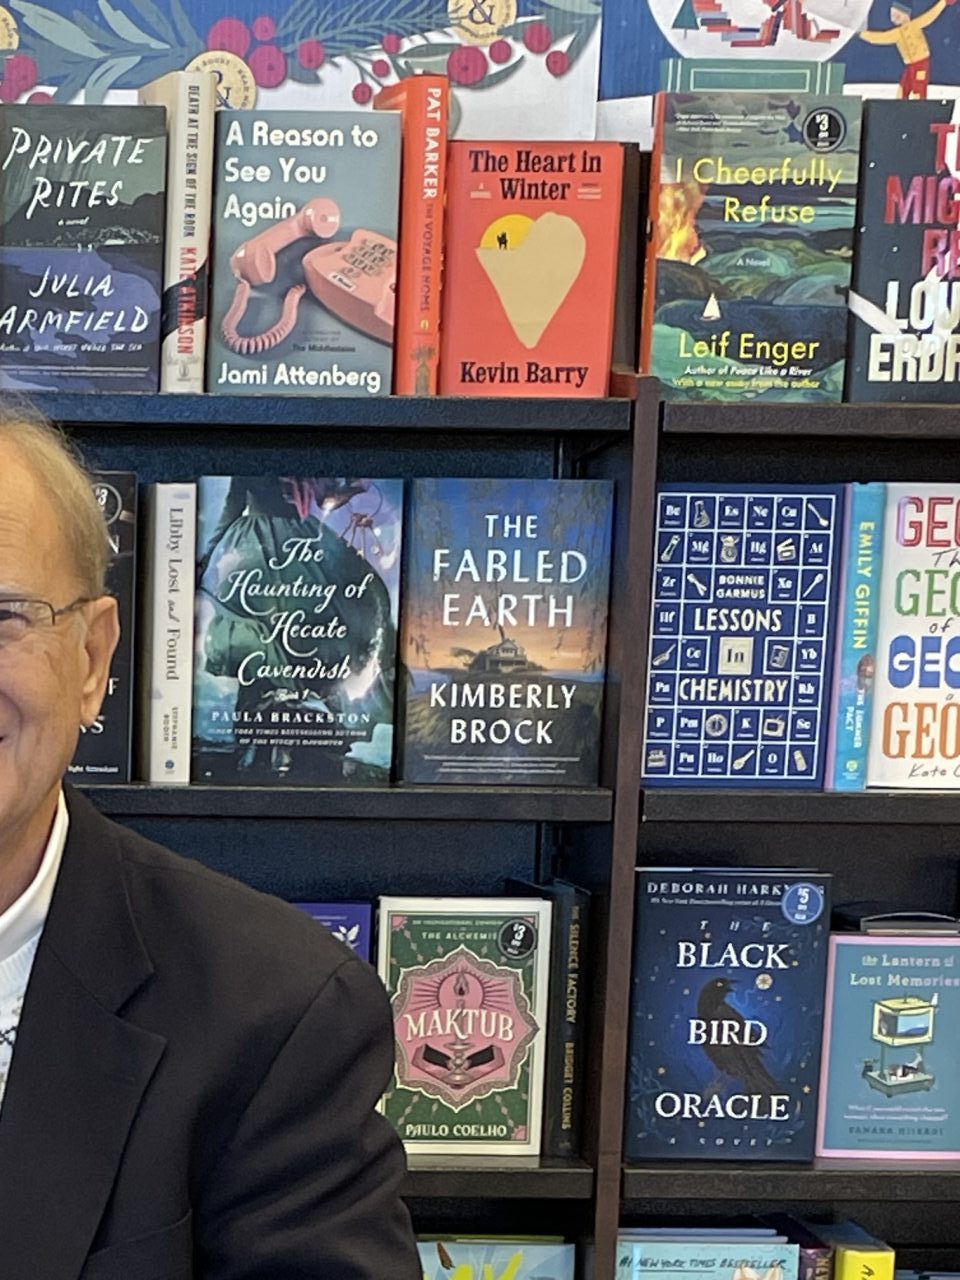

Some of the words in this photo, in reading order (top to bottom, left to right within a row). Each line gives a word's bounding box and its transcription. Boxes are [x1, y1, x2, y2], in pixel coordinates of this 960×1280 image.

[188, 85, 200, 114] DEATH
[427, 87, 441, 121] PAT
[187, 118, 198, 130] AT
[226, 120, 245, 147] A
[253, 120, 344, 148] Reason
[352, 124, 379, 148] to
[2, 127, 154, 171] PRIVATE
[186, 133, 198, 150] THE
[185, 153, 198, 174] SIGN
[224, 160, 271, 183] See
[280, 158, 327, 184] You
[423, 127, 440, 200] BARKER
[469, 150, 509, 173] The
[515, 150, 576, 173] Heart
[581, 150, 602, 173] in
[675, 157, 683, 184] I
[693, 157, 842, 193] Cheerfully
[185, 178, 197, 189] OF
[499, 178, 571, 201] Winter
[26, 180, 123, 219] RITES
[184, 193, 196, 209] THE
[223, 197, 297, 227] Again
[723, 195, 816, 224] Refuse
[184, 213, 196, 238] ROOK
[422, 222, 434, 271] VOYAGE
[179, 246, 198, 281] KATE
[737, 258, 746, 267] A
[748, 257, 771, 268] Novel
[28, 266, 115, 298] JULIA
[176, 286, 197, 354] ATKINSON
[679, 331, 731, 359] Leif
[739, 333, 820, 366] Enger
[218, 363, 268, 386] Jami
[273, 363, 382, 394] Attenberg
[461, 362, 520, 384] Kevin
[524, 362, 589, 388] Barry
[166, 507, 184, 554] Libby
[485, 514, 538, 539] THE
[269, 536, 324, 570] The
[857, 521, 876, 578] EMILY
[167, 558, 183, 594] Lost
[433, 549, 589, 584] FABLED
[718, 575, 765, 586] BONNIE
[219, 572, 336, 618] Haunting
[344, 572, 373, 599] of
[715, 588, 766, 599] GARMUS
[442, 593, 574, 628] EARTH
[693, 607, 783, 632] LESSONS
[852, 584, 871, 649] GIFFIN
[259, 611, 347, 657] Hecate
[929, 618, 953, 634] of
[166, 628, 181, 681] Found
[238, 650, 352, 687] Cavendish
[726, 648, 745, 663] In
[429, 683, 577, 710] KIMBERLY
[678, 677, 789, 702] CHEMISTRY
[211, 710, 264, 724] PAULA
[270, 711, 371, 724] BRACKSTON
[844, 705, 855, 731] PACT
[450, 718, 554, 745] BROCK
[908, 762, 948, 779] Kate
[647, 881, 729, 895] DEBORAH
[421, 931, 441, 941] THE
[567, 923, 580, 969] SILENCE
[676, 941, 790, 969] BLACK
[881, 954, 940, 968] Lantern
[850, 973, 882, 987] Lost
[887, 974, 960, 988] Memories
[566, 973, 578, 1024] FACTORY
[403, 1008, 515, 1042] MAKTUB
[687, 1019, 768, 1047] BIRD
[563, 1042, 574, 1084] BRIDGET
[561, 1087, 574, 1130] COLLINS
[654, 1092, 791, 1121] ORACLE
[405, 1124, 450, 1137] PAULO
[452, 1125, 508, 1138] COELHO
[638, 1257, 658, 1269] NEW
[660, 1258, 686, 1269] YORK
[689, 1258, 716, 1268] TIMES
[719, 1257, 788, 1271] BESTSELLER
